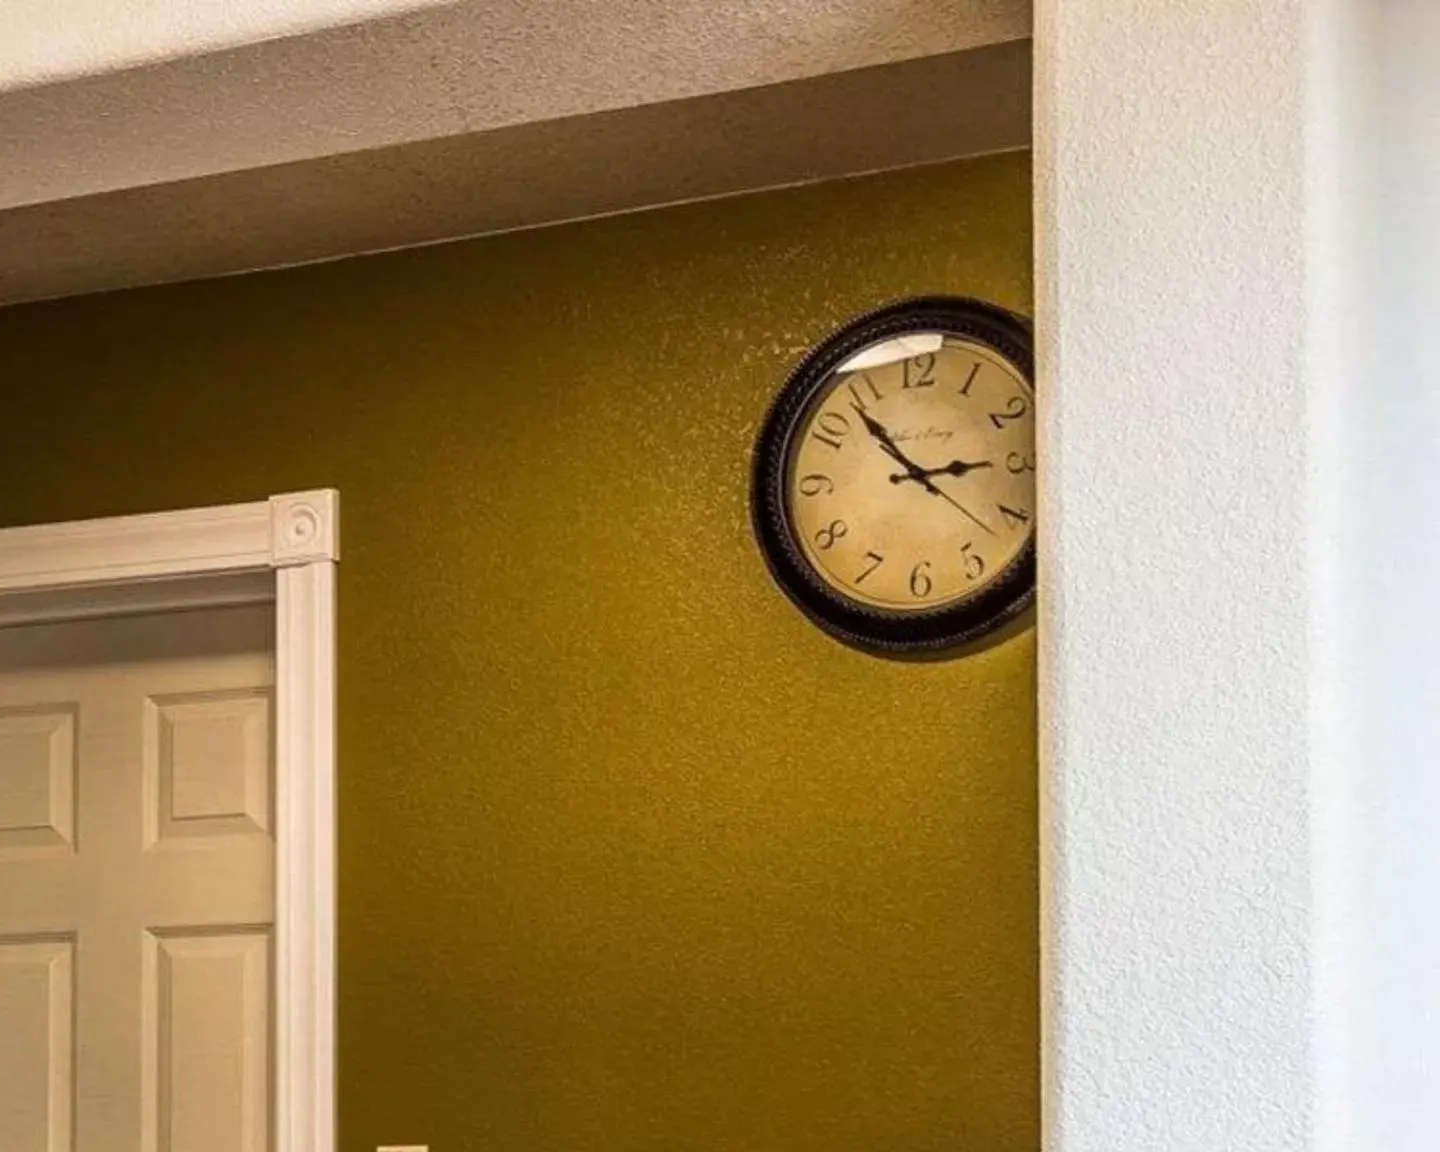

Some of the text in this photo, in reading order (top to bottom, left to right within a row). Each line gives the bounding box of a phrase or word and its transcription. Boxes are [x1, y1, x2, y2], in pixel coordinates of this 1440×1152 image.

[899, 353, 936, 390] 12
[957, 362, 982, 398] 1
[847, 373, 885, 412] 11
[988, 396, 1026, 430] 2
[812, 411, 852, 451] 10
[1006, 451, 1034, 474] 3
[799, 473, 834, 498] 9
[814, 519, 849, 550] 8
[996, 503, 1029, 531] 4
[855, 551, 884, 584] 7
[960, 542, 985, 580] 5
[910, 560, 933, 598] 6
